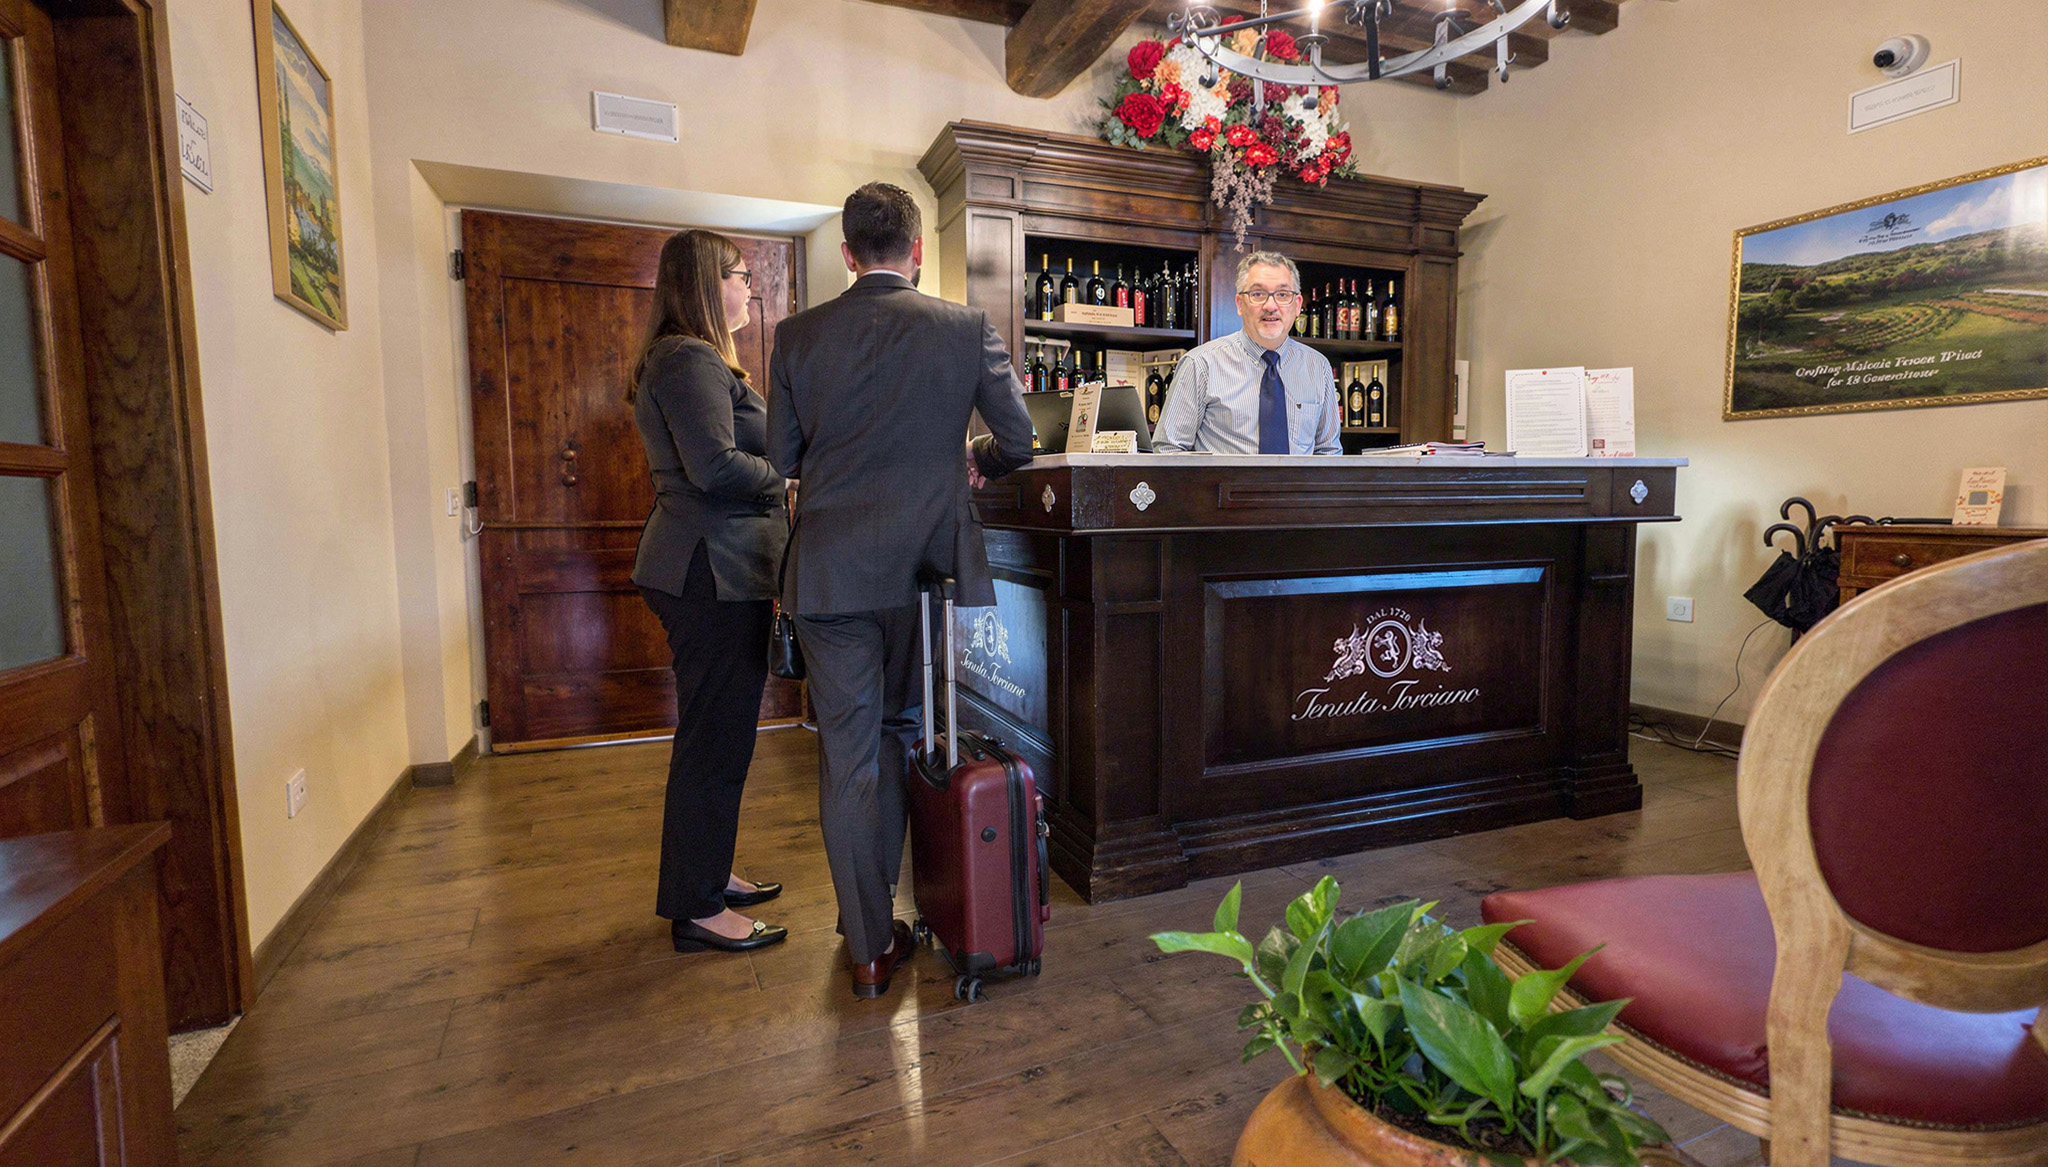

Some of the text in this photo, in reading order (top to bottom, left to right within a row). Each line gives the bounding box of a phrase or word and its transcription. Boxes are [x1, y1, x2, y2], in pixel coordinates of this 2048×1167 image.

[1823, 377, 1844, 390] for
[1366, 607, 1411, 624] DAL 1720
[960, 648, 1027, 699] Tenuta Torciano
[1290, 679, 1480, 721] Tenuta Torciano
